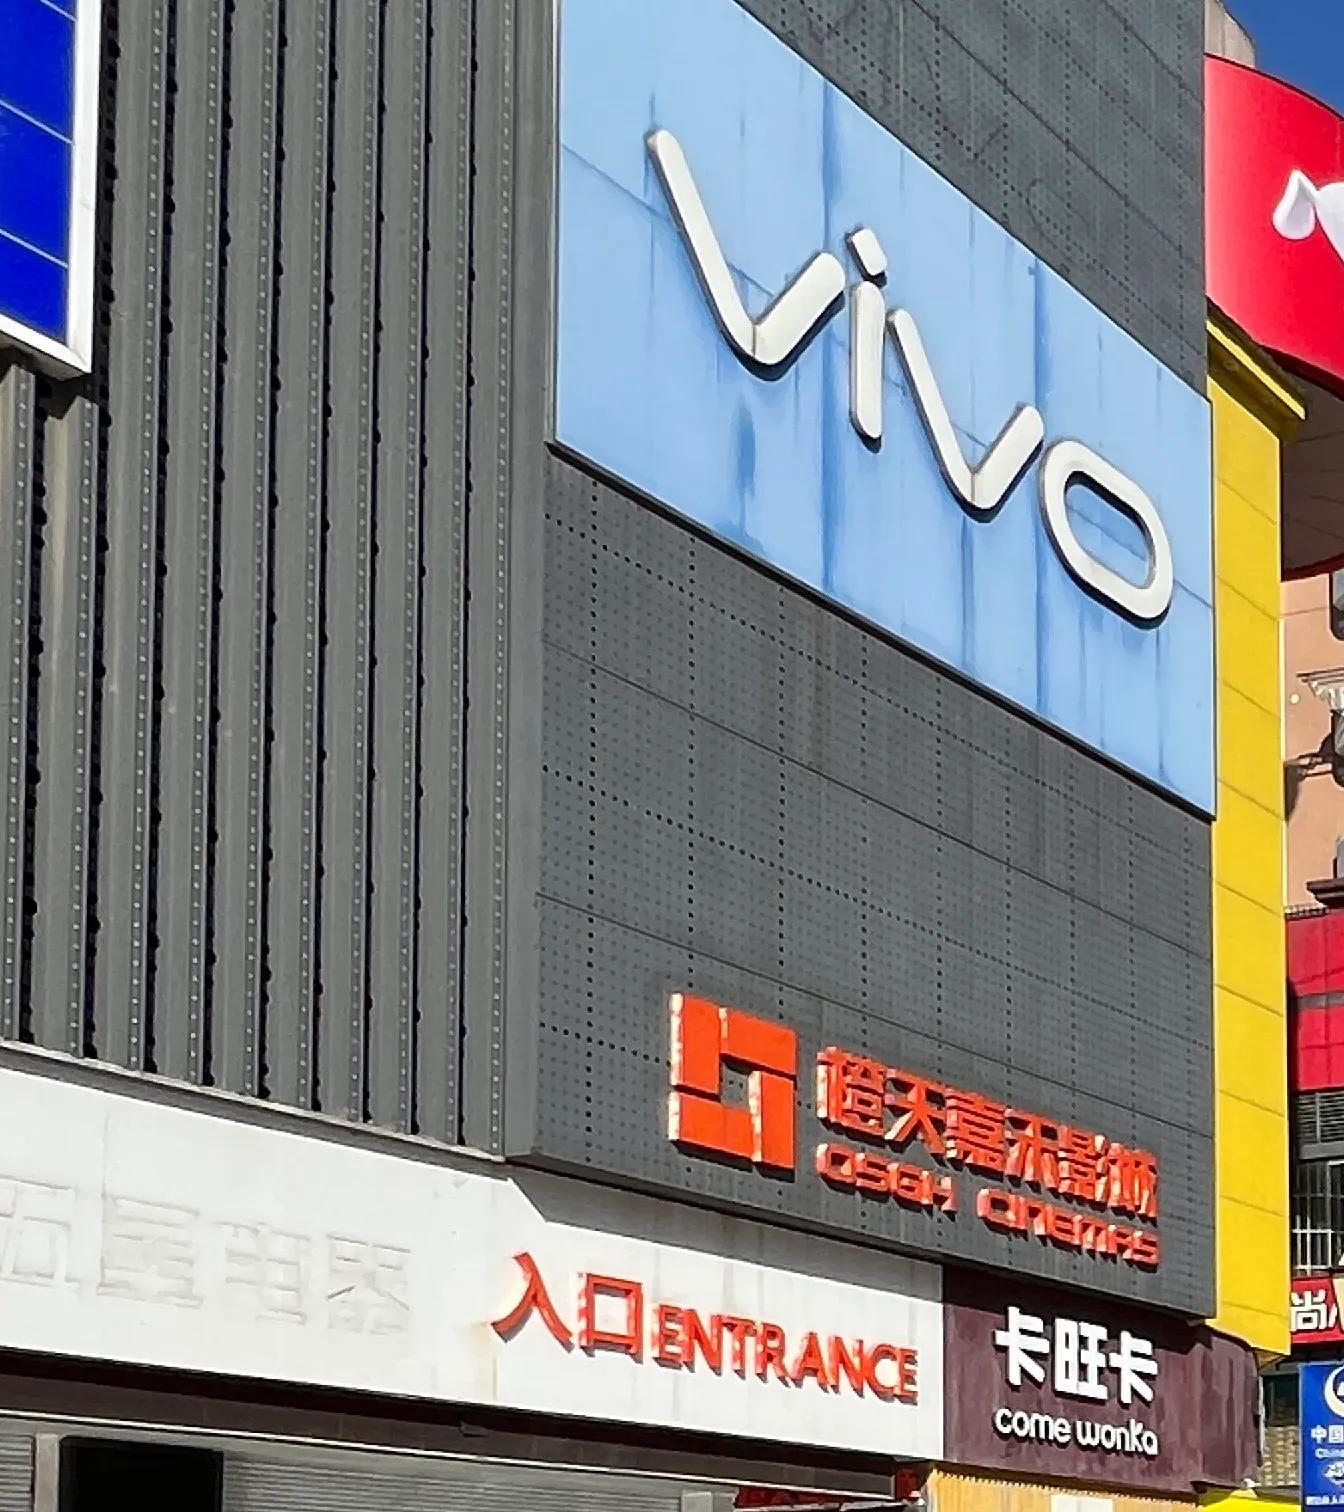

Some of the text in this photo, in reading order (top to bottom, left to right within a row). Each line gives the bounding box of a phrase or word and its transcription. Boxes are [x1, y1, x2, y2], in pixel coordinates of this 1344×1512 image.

[646, 127, 1174, 620] vivo
[816, 1045, 1160, 1220] 橙天嘉禾影城
[490, 1251, 919, 1405] 入口 ENTRANCE
[994, 1305, 1159, 1405] 卡旺卡
[994, 1407, 1072, 1444] come
